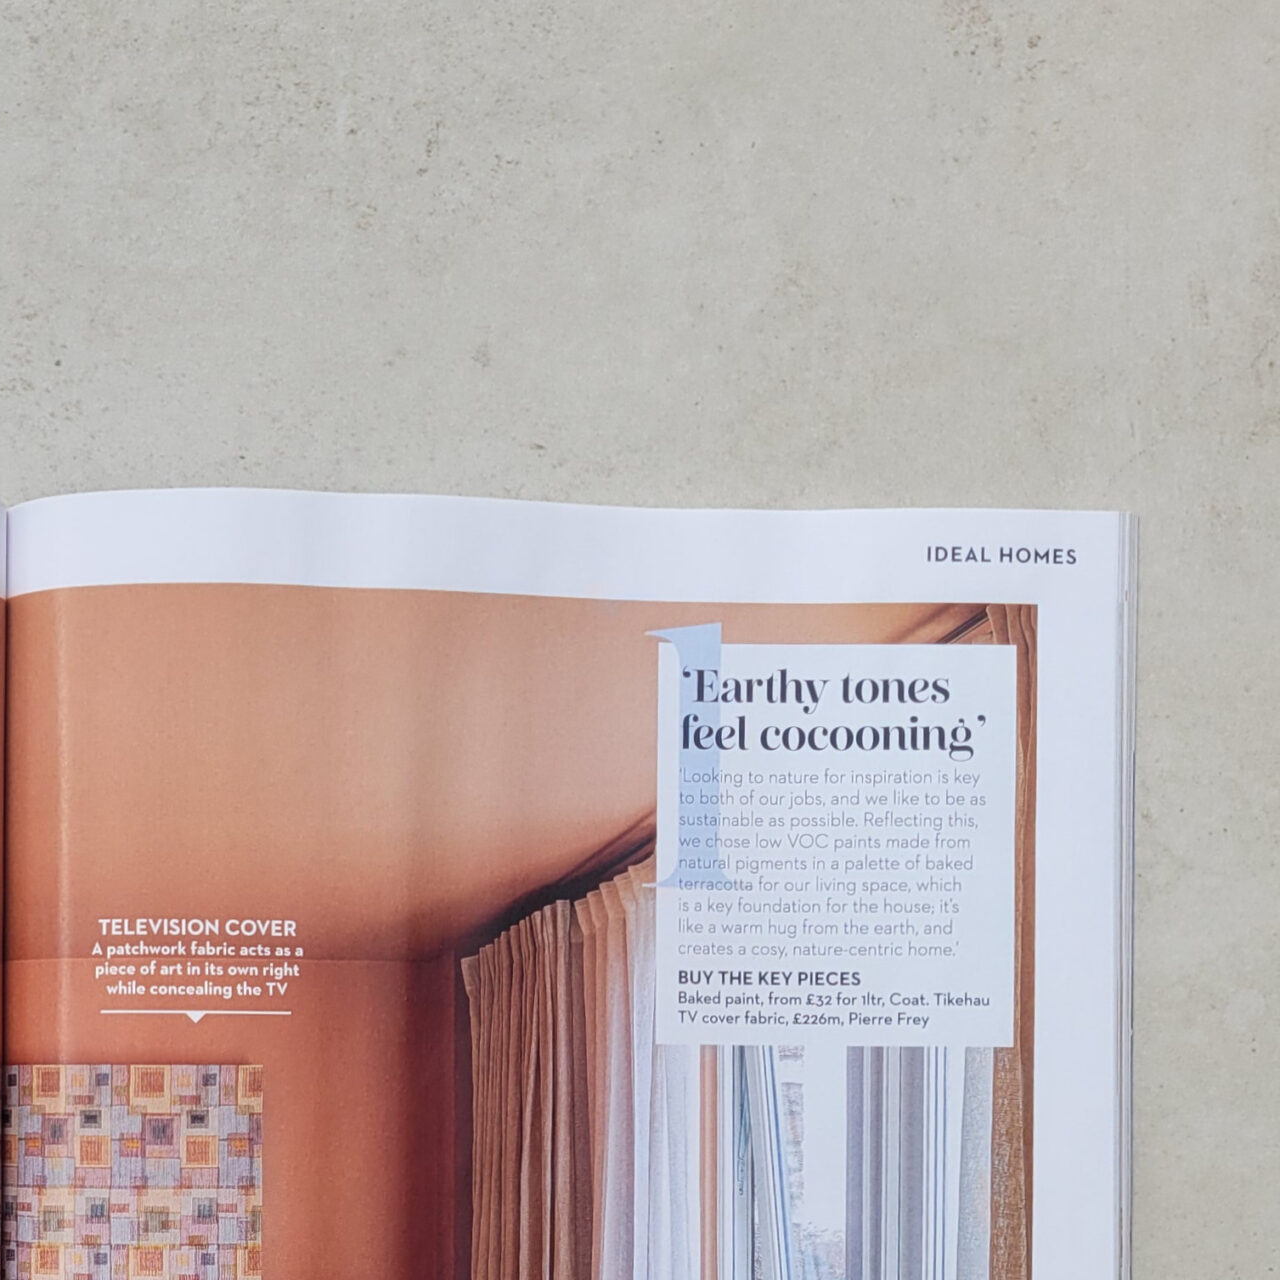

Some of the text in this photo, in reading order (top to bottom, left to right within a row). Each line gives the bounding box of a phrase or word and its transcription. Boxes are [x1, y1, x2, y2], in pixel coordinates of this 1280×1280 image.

[927, 546, 1076, 564] IDEAL HOMES
[842, 672, 951, 704] tones
[681, 713, 749, 750] feel
[679, 767, 980, 790] 'Looking to nature for inspiration is key
[679, 811, 978, 832] sustainable as possible. Reflecting this,
[679, 897, 959, 918] is a key foundation for the house; it's
[98, 919, 296, 936] TELEVISION COVER
[92, 941, 303, 959] A patchwork fabric acts as a
[678, 941, 959, 960] creates a cosy, nature-centric home.'
[96, 962, 299, 980] piece of art in its own right
[679, 970, 861, 986] BUY THE KEY PIECES
[107, 981, 288, 999] while concealing the TV
[678, 990, 990, 1008] Baked paint, from £32 for 1ltr, Coat. Tikehau
[678, 1011, 929, 1029] TV cover fabric, £226m, Pierre Frey
